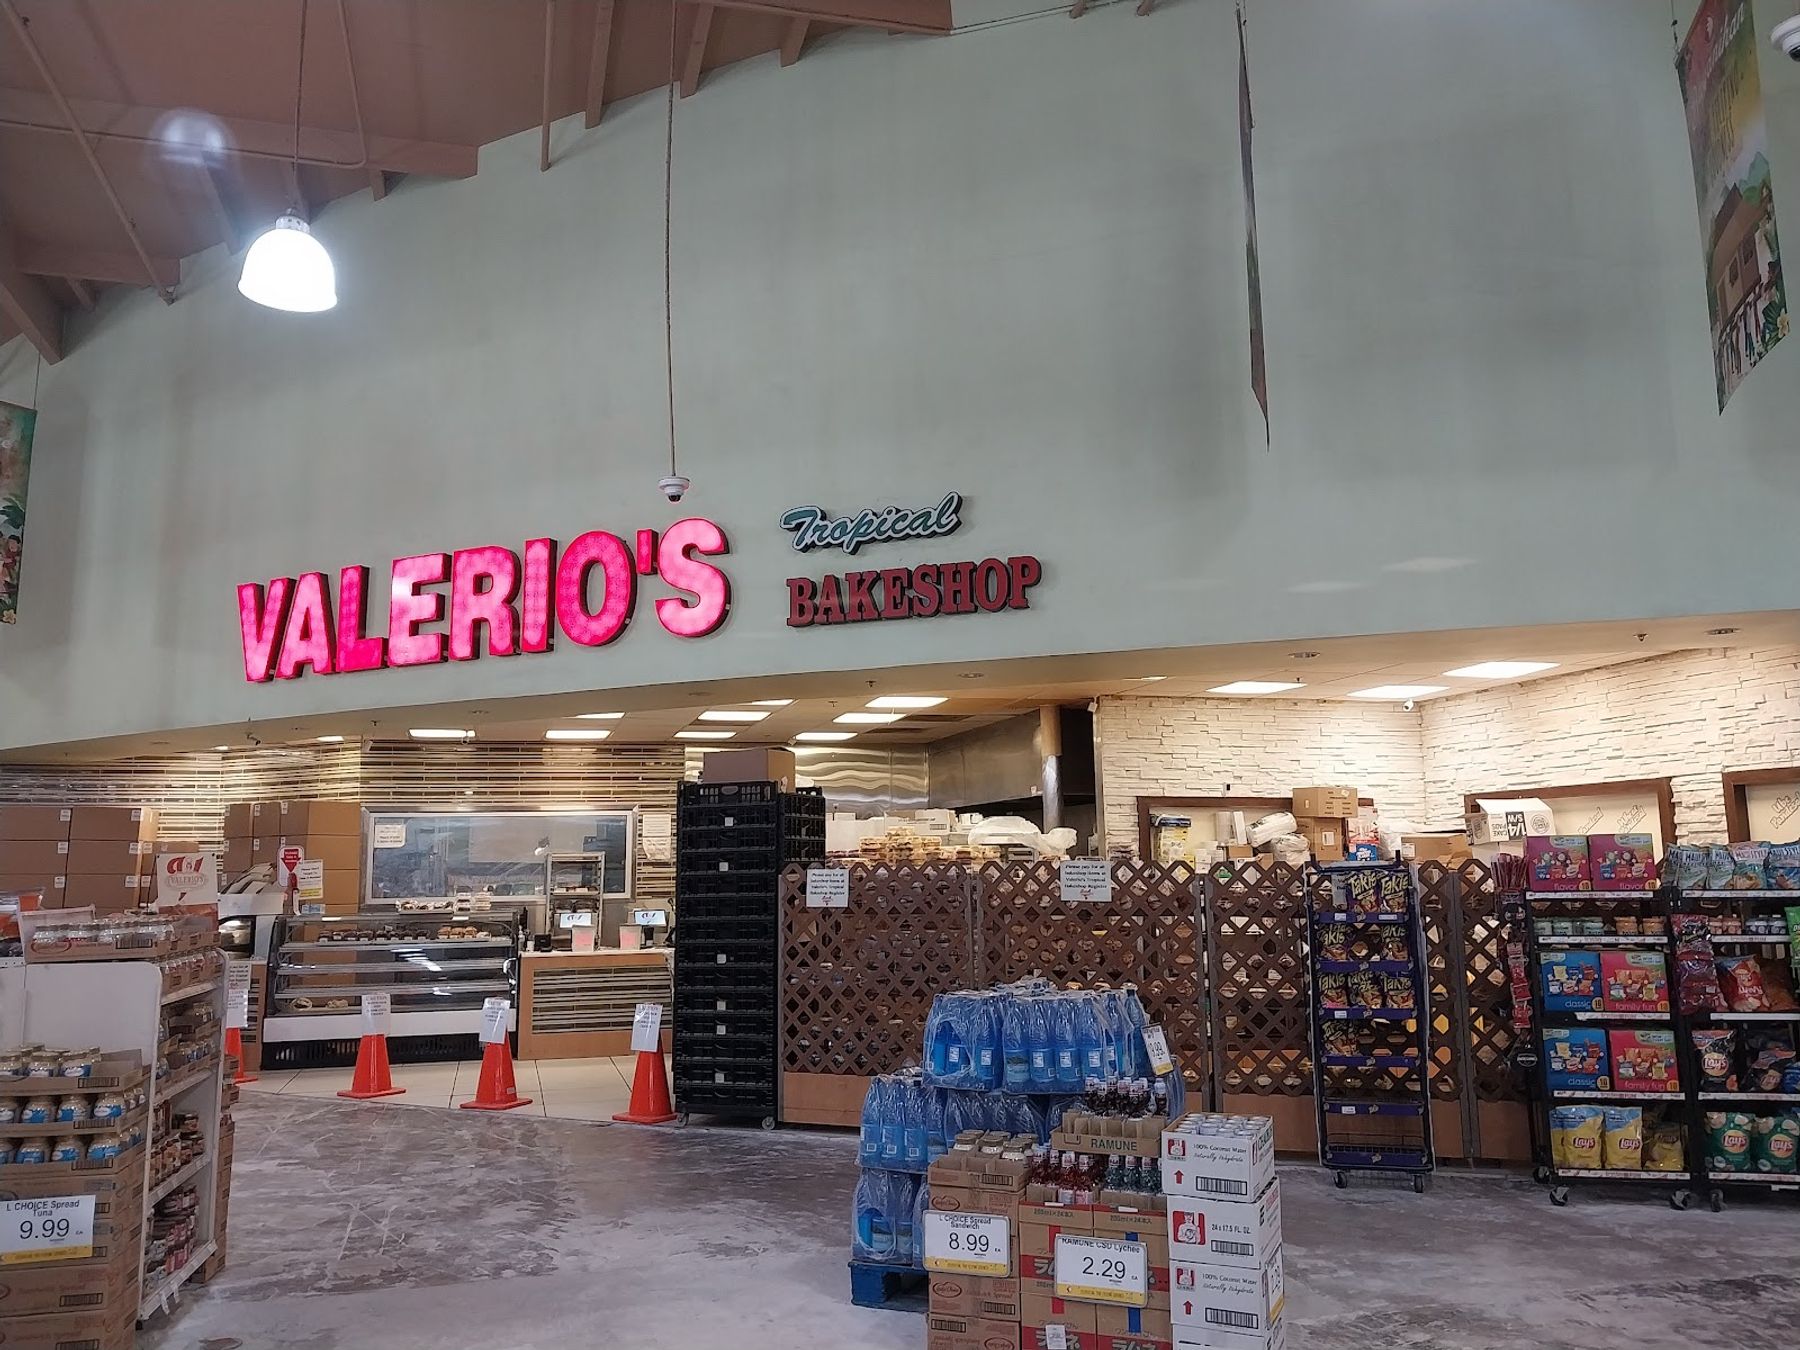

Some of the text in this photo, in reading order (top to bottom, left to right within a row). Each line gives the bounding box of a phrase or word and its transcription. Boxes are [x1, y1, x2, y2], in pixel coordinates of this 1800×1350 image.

[780, 491, 963, 554] Tropical
[237, 517, 731, 682] VALERIO'S
[787, 556, 1041, 627] BAKESHOP
[1349, 873, 1376, 898] Takis
[1381, 876, 1408, 897] Takis
[1091, 1138, 1138, 1151] RAMUNE
[15, 1201, 49, 1211] CHOICE
[51, 1200, 80, 1210] Spread
[34, 1209, 53, 1217] Tuna
[20, 1218, 70, 1240] 9.99
[944, 1215, 968, 1223] CHOICE
[970, 1216, 992, 1225] Spread
[950, 1220, 980, 1230] Sandwich
[949, 1232, 989, 1252] 8.99
[1114, 1244, 1140, 1254] Lychee
[1082, 1256, 1126, 1279] 2.29
